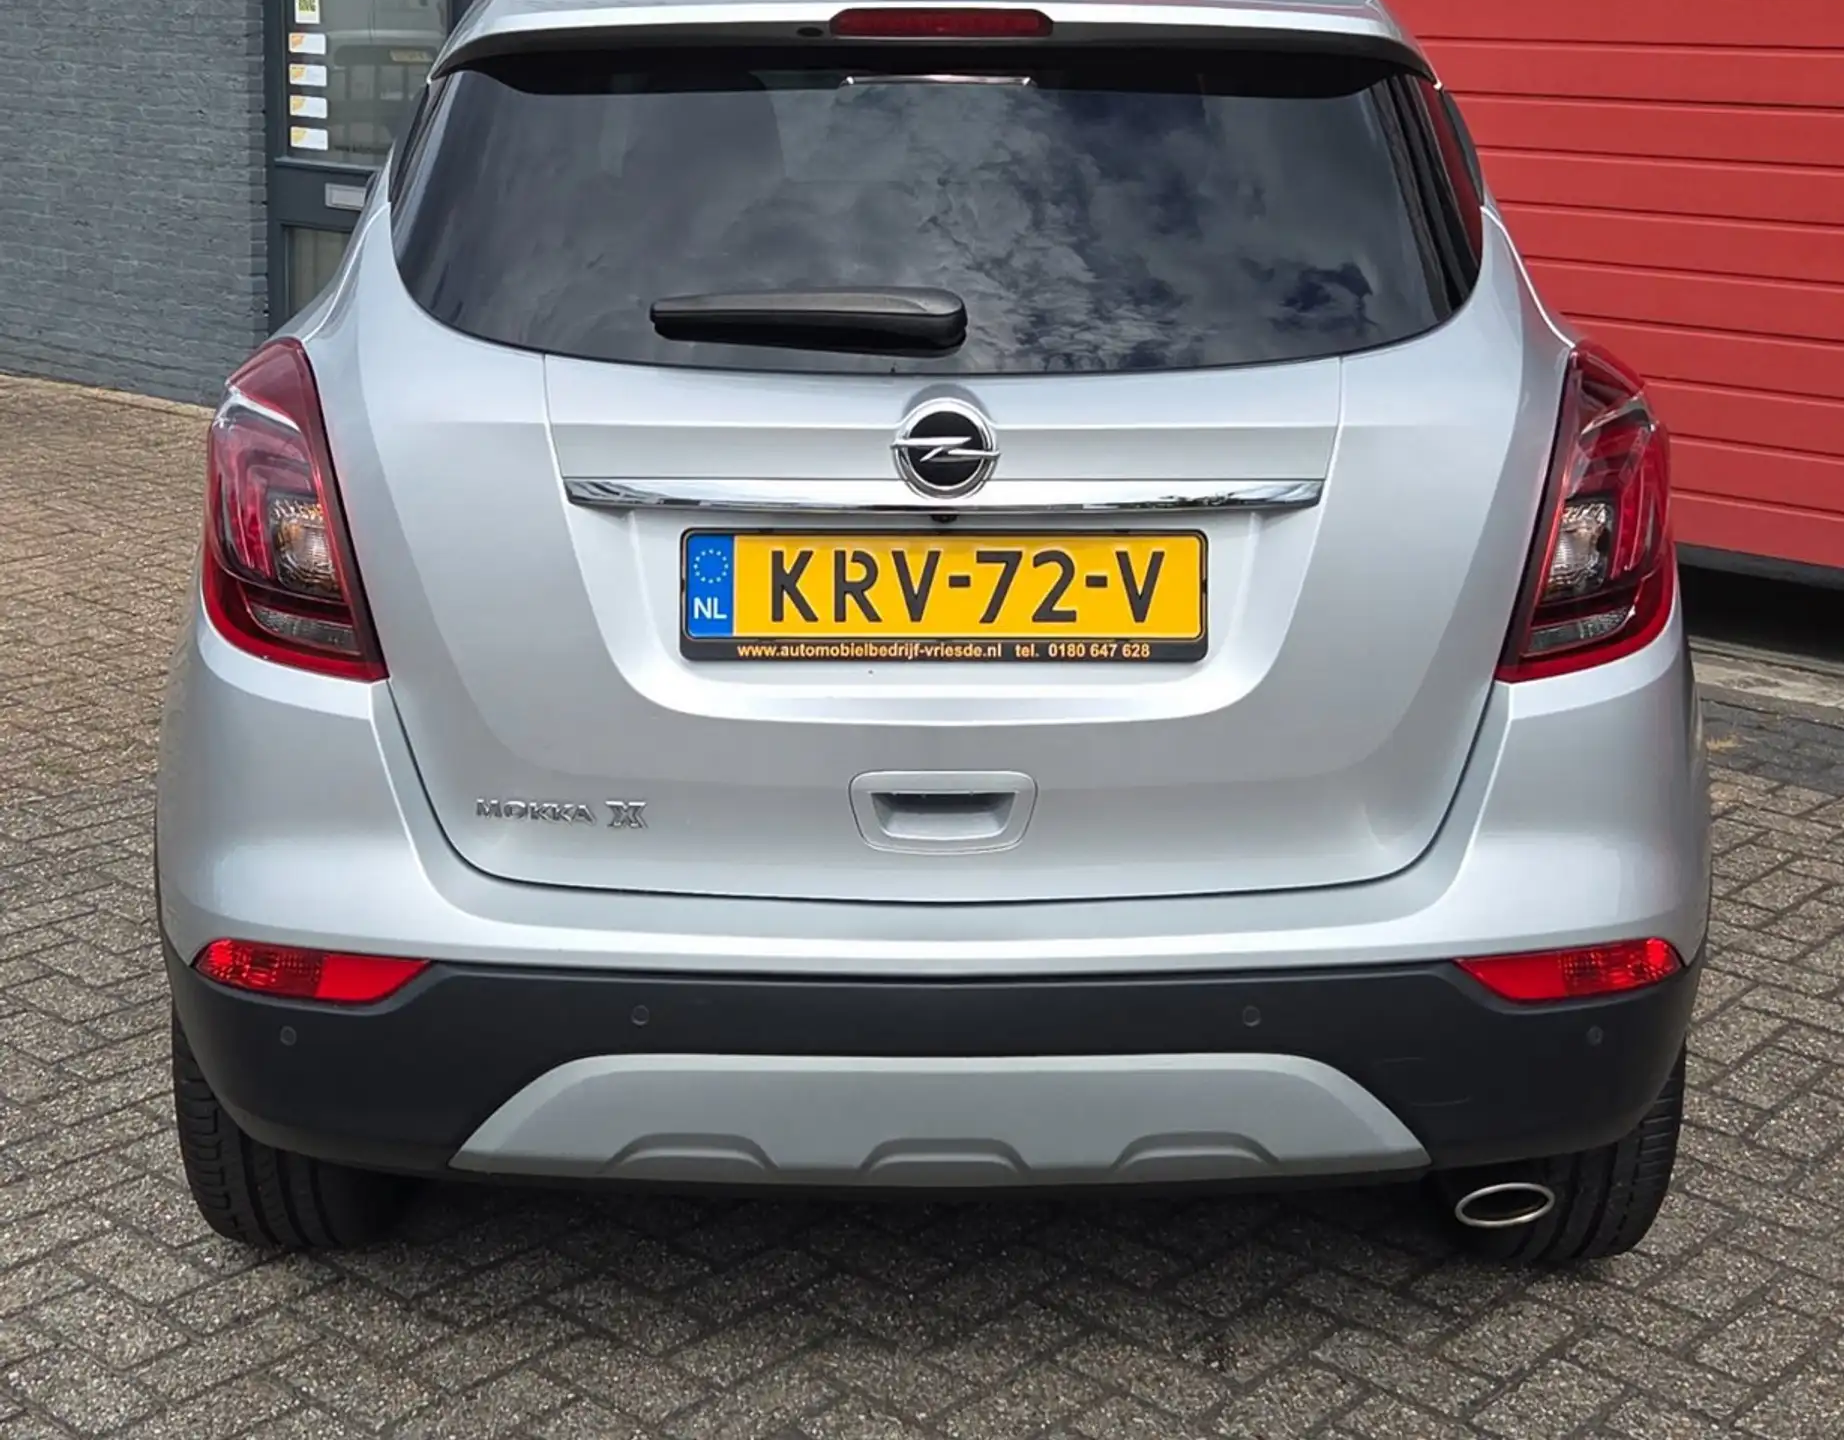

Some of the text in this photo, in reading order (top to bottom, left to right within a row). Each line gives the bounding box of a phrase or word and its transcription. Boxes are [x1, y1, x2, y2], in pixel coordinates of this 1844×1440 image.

[770, 549, 1166, 624] KRV-72-V
[693, 598, 728, 620] NL
[737, 642, 1151, 660] www.automobielbedrijf-vriesde.nl tel. 0180 647 628
[476, 798, 648, 828] MOKKA X
